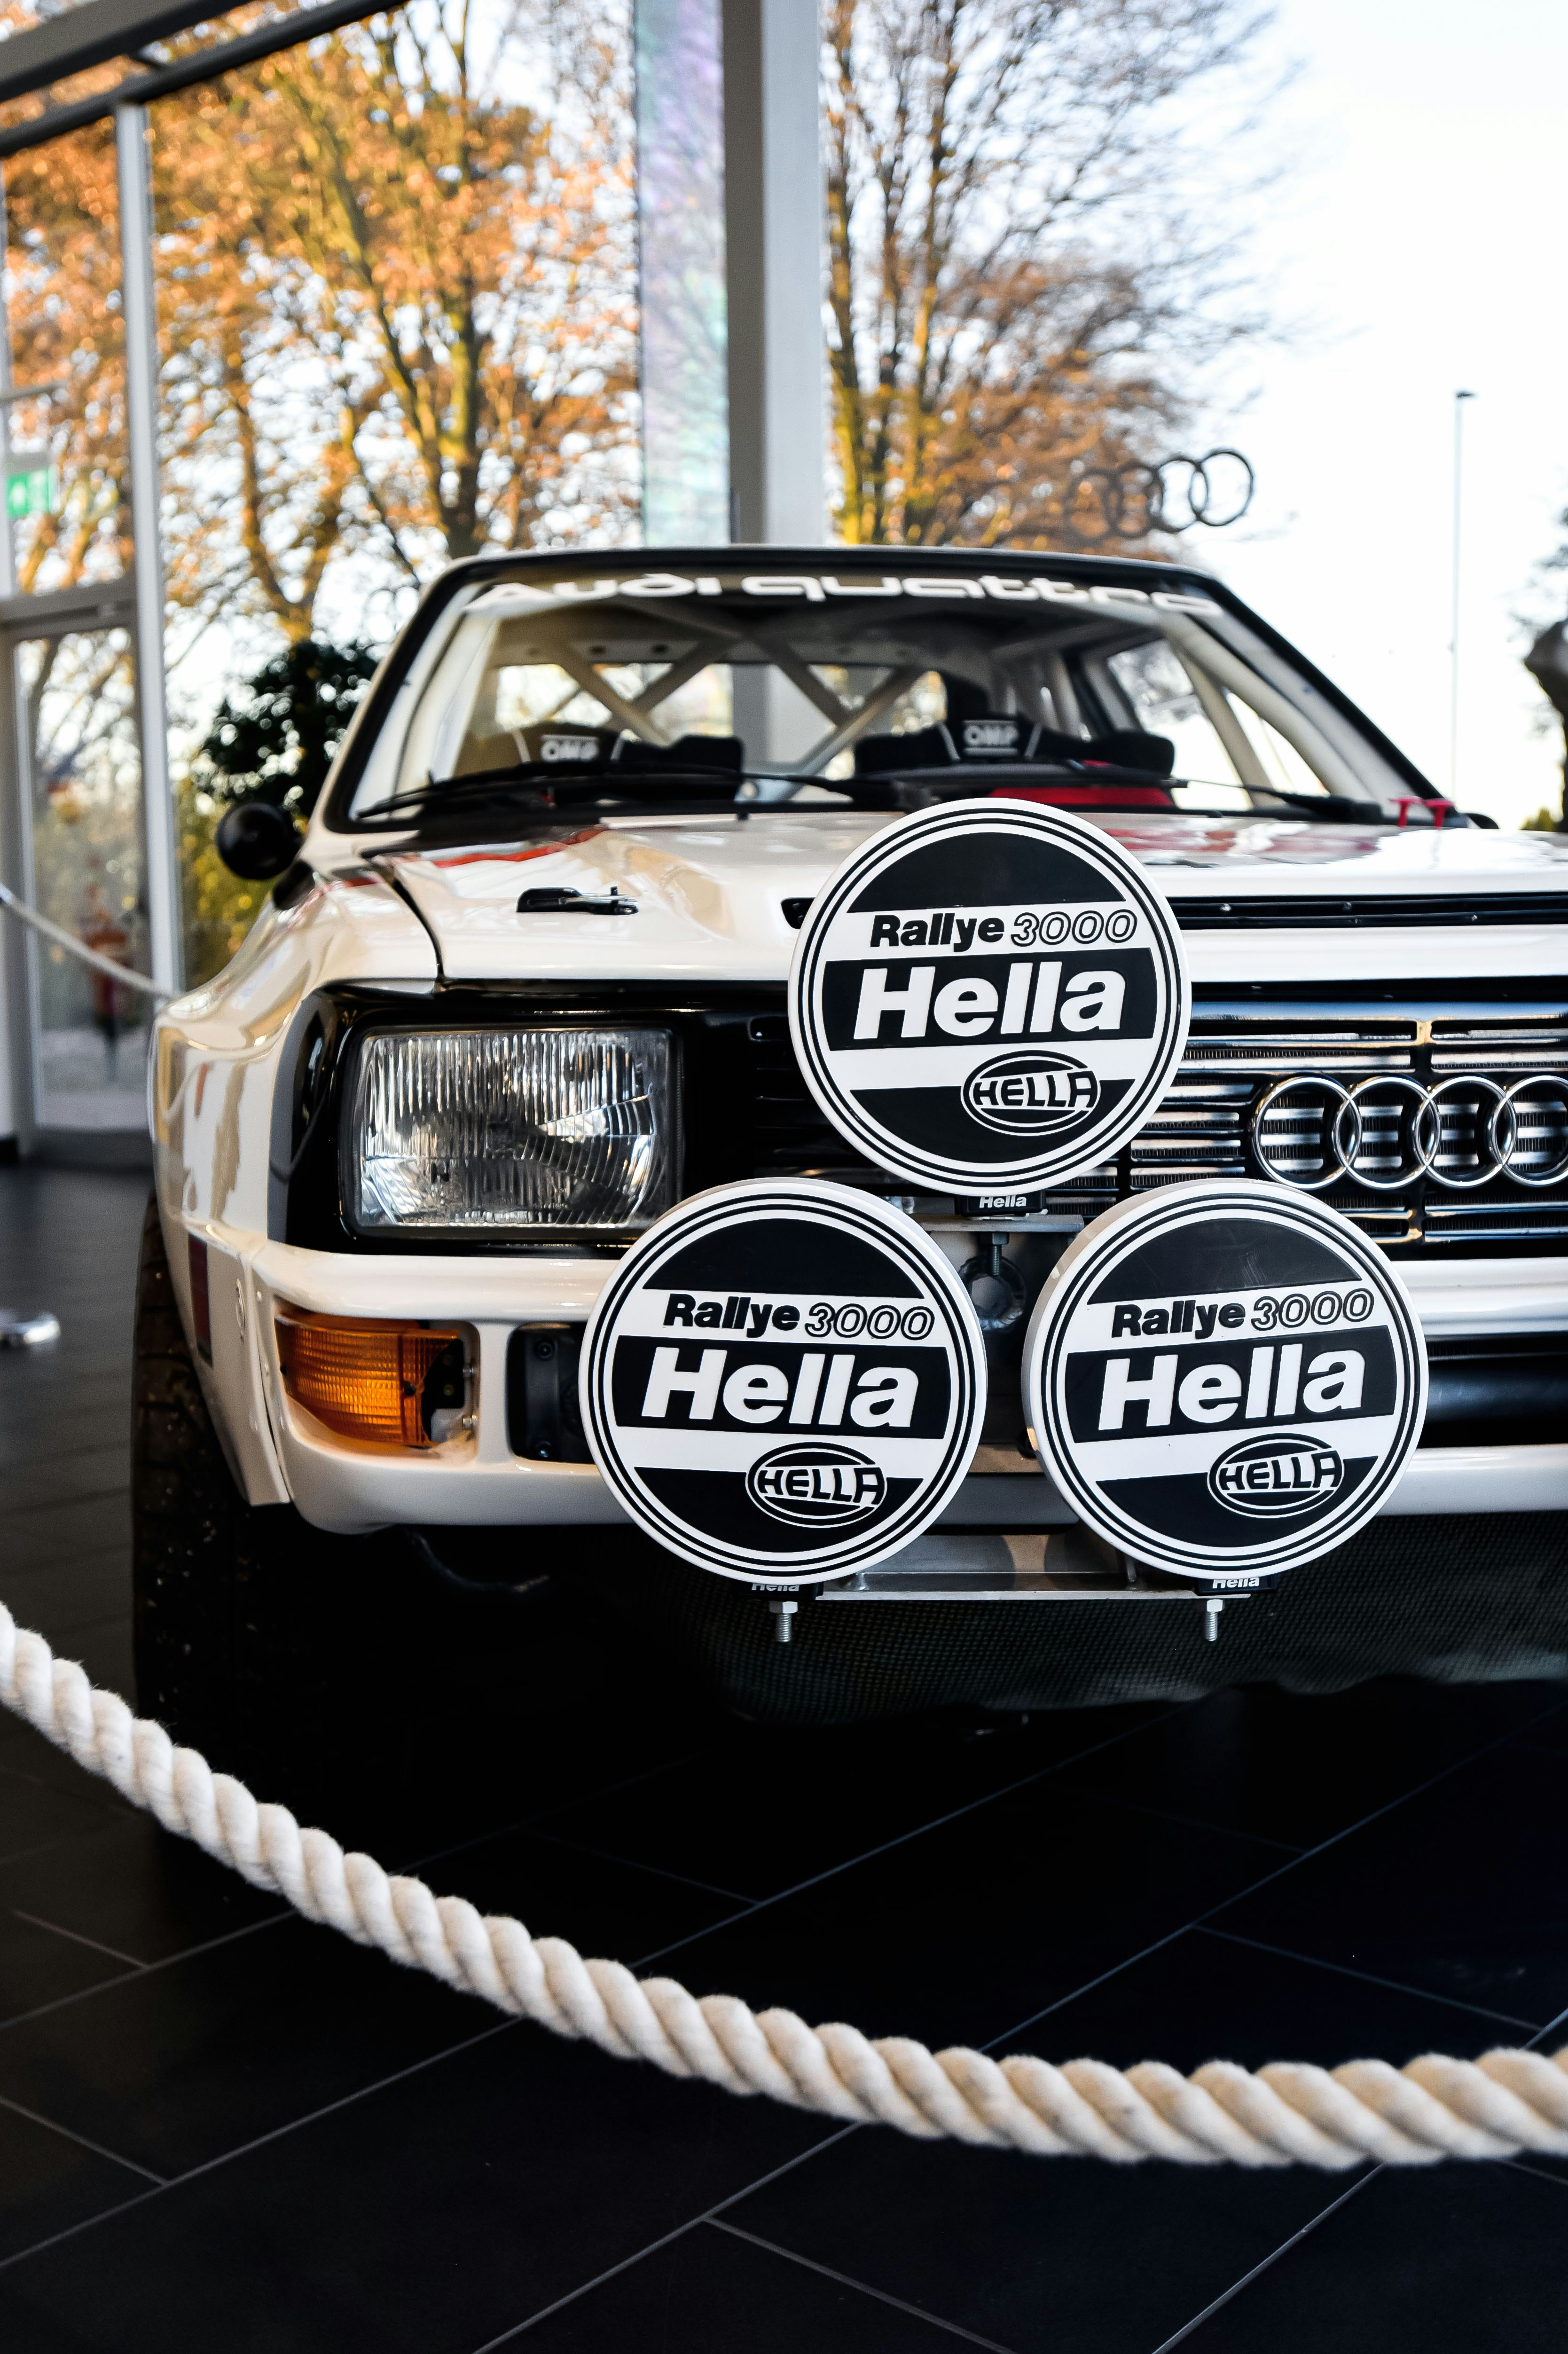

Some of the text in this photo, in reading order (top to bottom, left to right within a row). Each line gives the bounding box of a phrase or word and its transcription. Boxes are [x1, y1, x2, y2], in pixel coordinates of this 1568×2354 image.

[740, 574, 1223, 616] quattro
[870, 909, 1138, 953] Rallye 3000
[853, 961, 1126, 1040] Hella
[974, 1070, 1097, 1109] HELLA
[979, 1195, 1027, 1208] Hella
[663, 1294, 935, 1341] Rallye 3000
[1112, 1288, 1374, 1340] Rallye 3000
[640, 1347, 920, 1428] Hella
[1098, 1342, 1366, 1431] Hella
[757, 1466, 883, 1506] HELLA
[1220, 1449, 1341, 1491] HELLA
[1212, 1577, 1260, 1589] Hella
